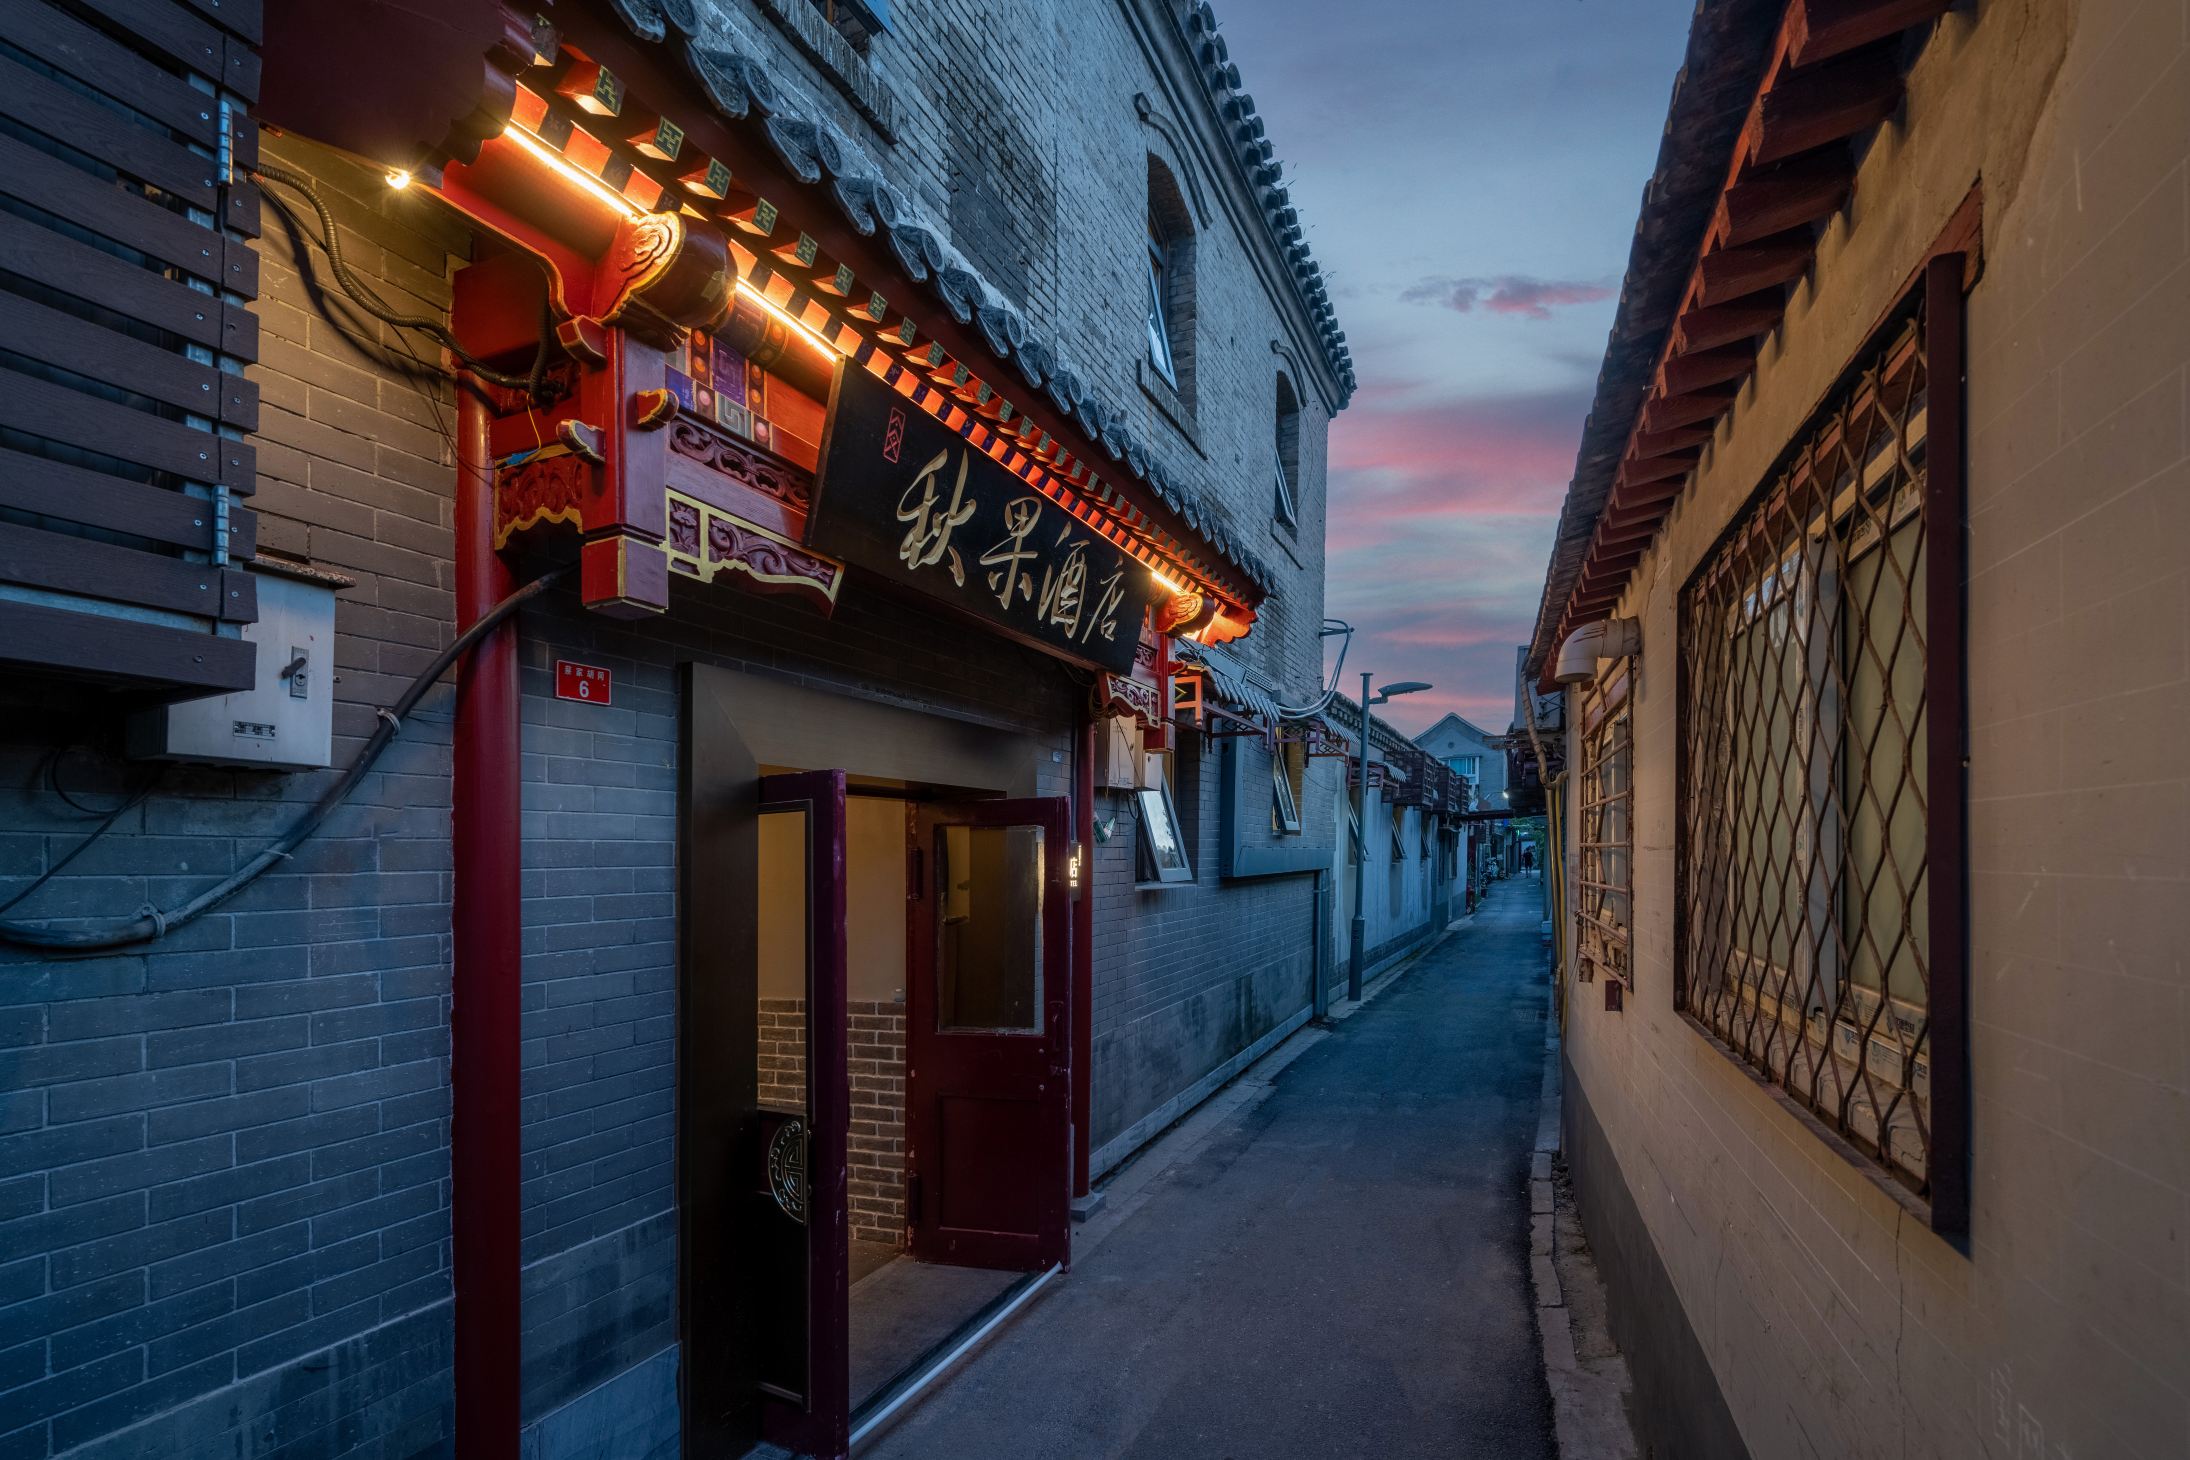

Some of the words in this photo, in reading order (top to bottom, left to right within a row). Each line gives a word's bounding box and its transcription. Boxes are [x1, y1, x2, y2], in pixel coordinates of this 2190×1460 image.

[897, 448, 1125, 644] 秋果酒店
[579, 680, 589, 698] 6
[1069, 857, 1078, 879] 店
